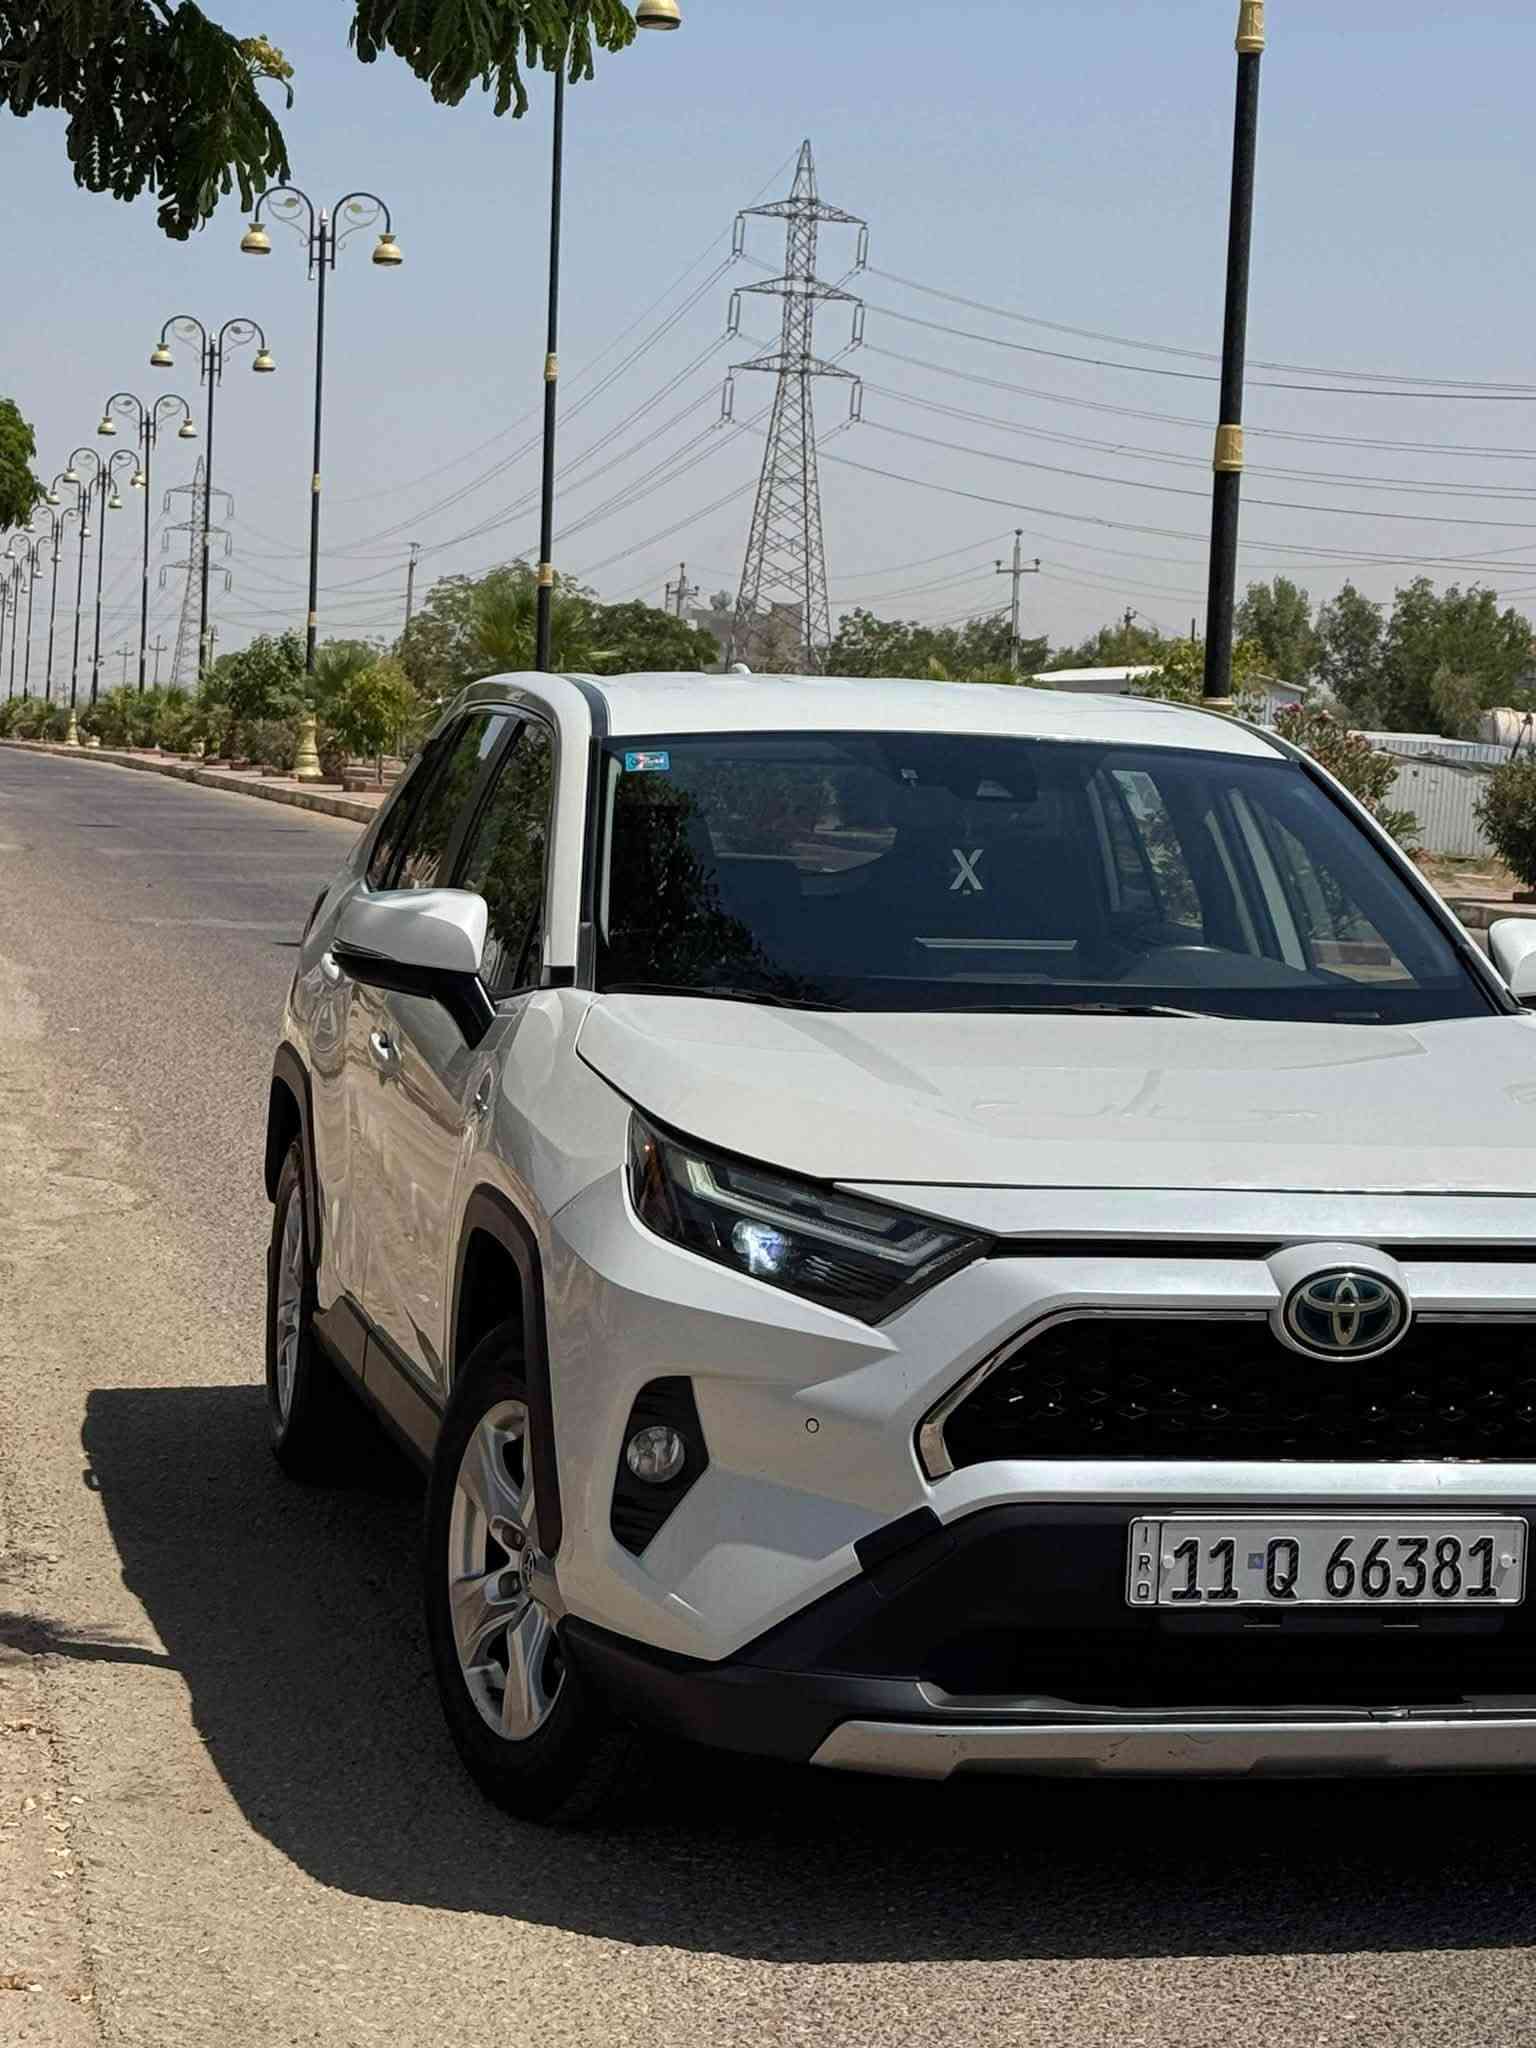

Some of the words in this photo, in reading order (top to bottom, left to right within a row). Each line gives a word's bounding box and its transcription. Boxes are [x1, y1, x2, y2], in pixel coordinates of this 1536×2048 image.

[1172, 1538, 1240, 1600] 11
[1266, 1538, 1300, 1599] Q
[1326, 1537, 1497, 1598] 66381
